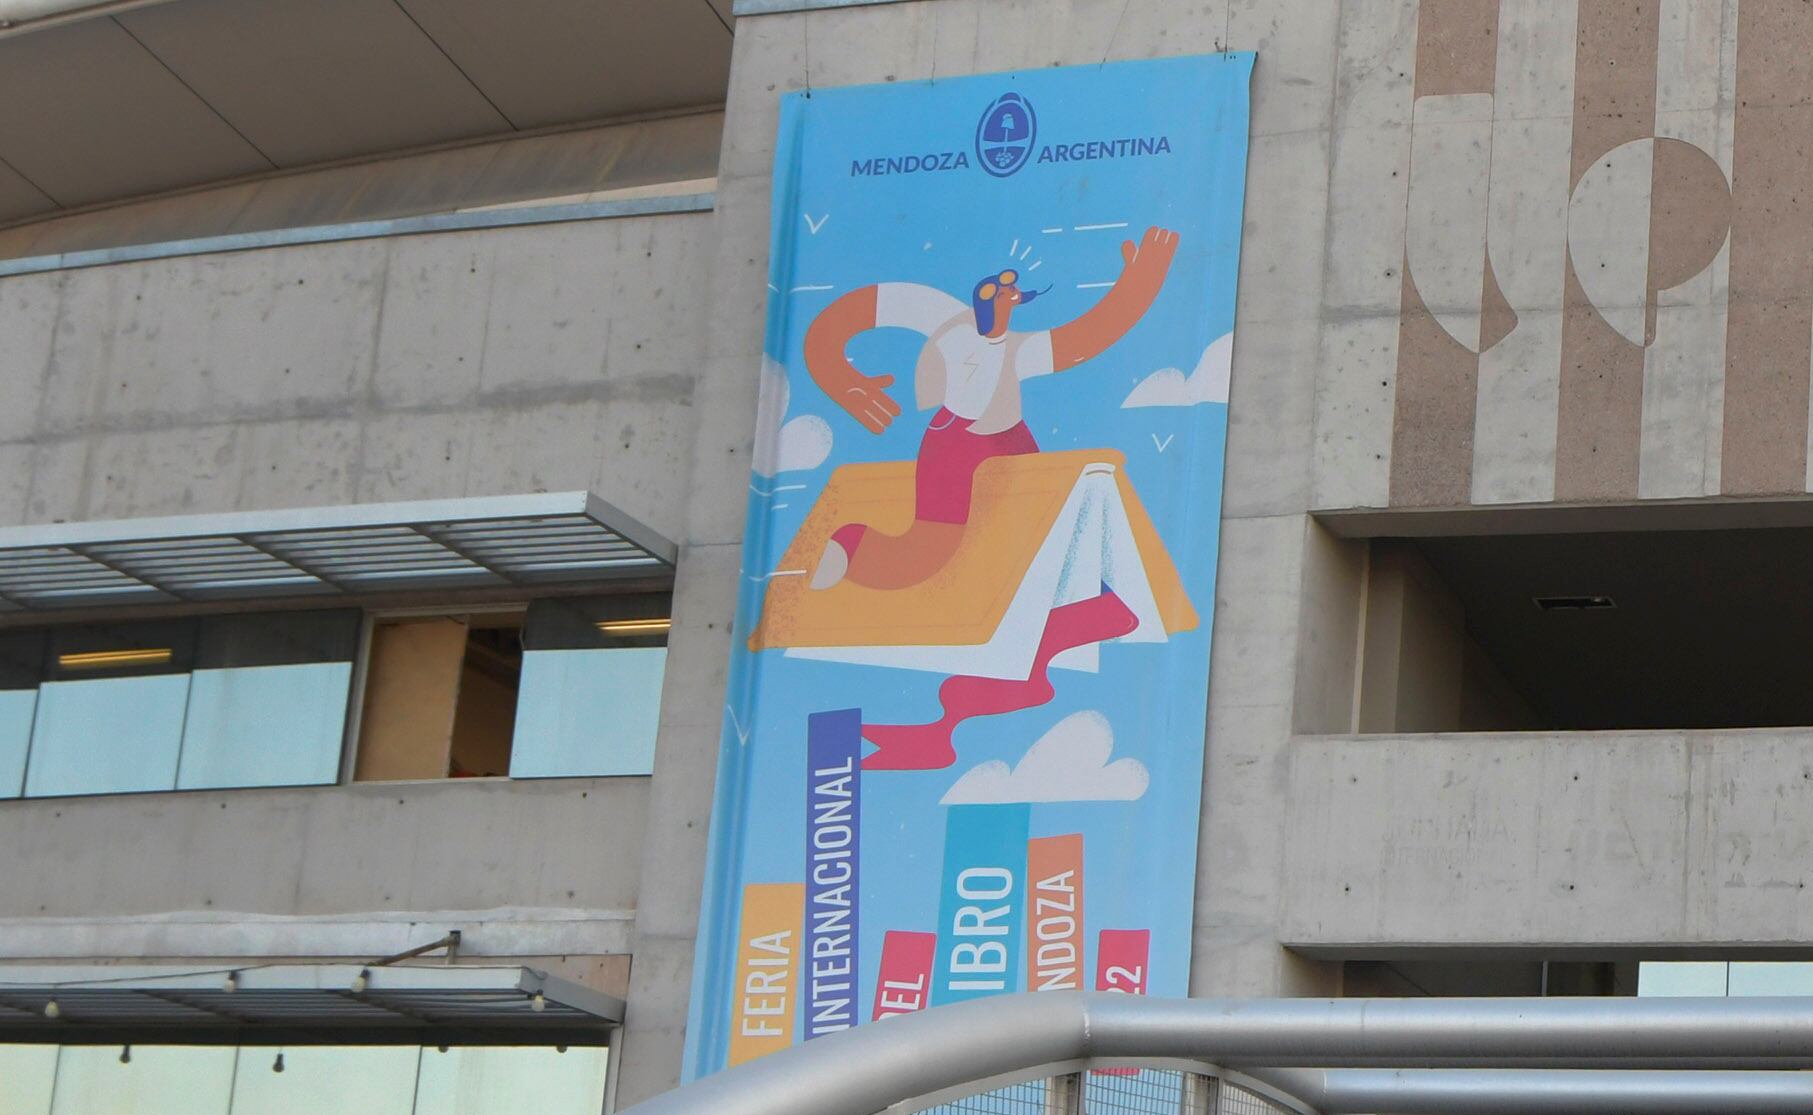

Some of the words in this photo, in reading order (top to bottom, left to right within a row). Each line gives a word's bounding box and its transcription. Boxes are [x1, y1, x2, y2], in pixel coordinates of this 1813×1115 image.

[850, 151, 970, 178] MENDOZA
[1036, 135, 1172, 165] ARGENTINA
[811, 755, 854, 1035] INTERNACIONAL
[948, 867, 1013, 991] IBRO
[1036, 869, 1076, 991] NDOZA
[741, 928, 793, 1038] FERIA
